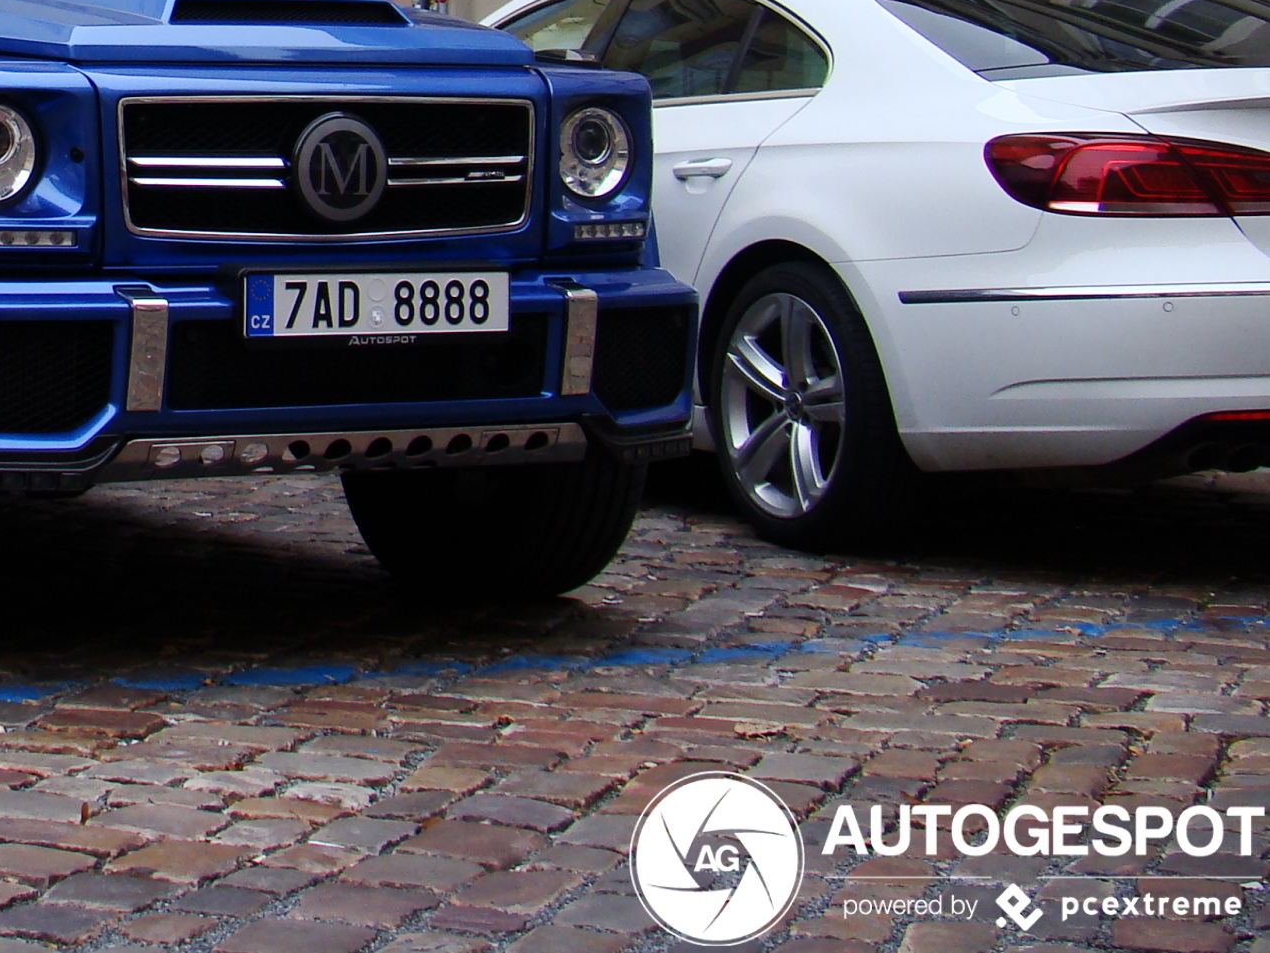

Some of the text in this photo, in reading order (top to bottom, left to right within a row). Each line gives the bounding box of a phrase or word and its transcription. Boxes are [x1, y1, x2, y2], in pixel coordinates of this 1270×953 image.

[316, 142, 370, 196] M
[250, 314, 271, 329] CZ
[285, 279, 490, 329] 7AD 8888
